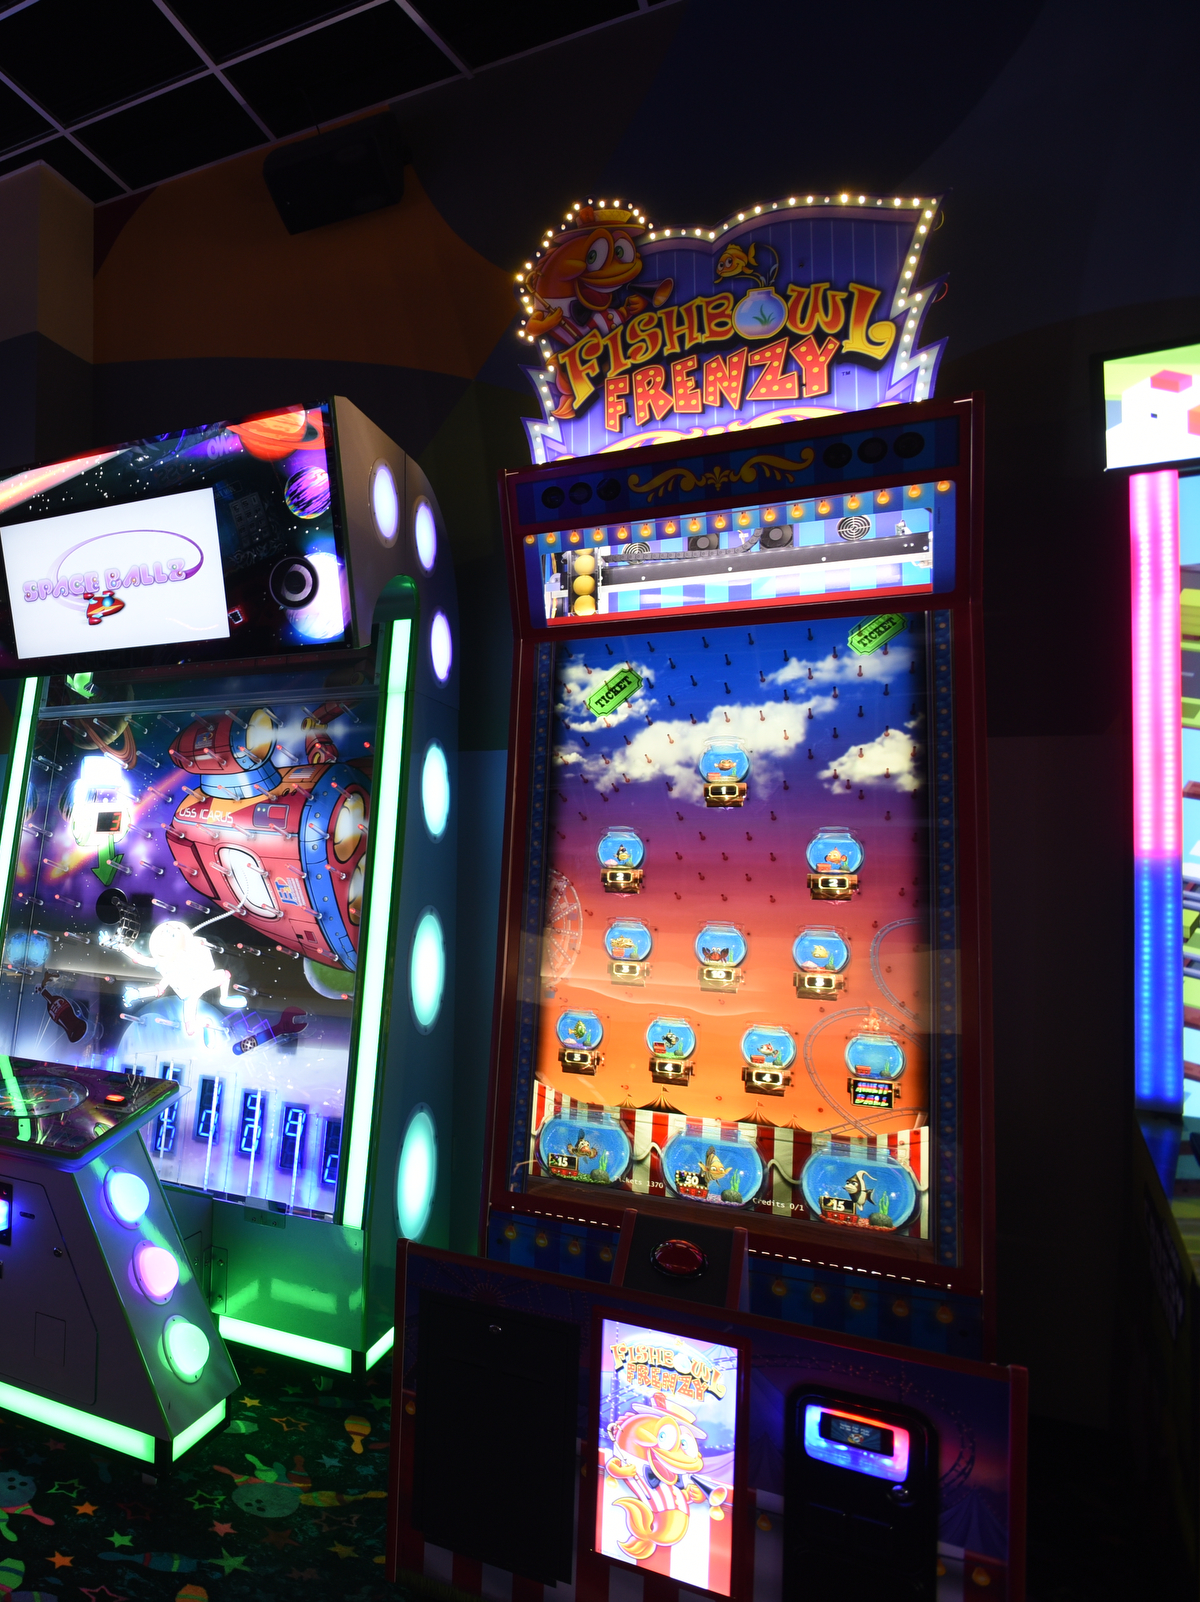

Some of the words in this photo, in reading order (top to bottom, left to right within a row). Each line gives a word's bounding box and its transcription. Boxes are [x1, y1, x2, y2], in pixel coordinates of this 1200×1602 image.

[604, 334, 841, 432] FRENZY
[22, 570, 100, 602] SPACE
[856, 616, 898, 648] TICKET
[594, 675, 633, 708] TICKET
[109, 812, 122, 831] 3
[178, 807, 198, 819] USS
[199, 810, 234, 824] ICARUS
[558, 1156, 569, 1168] 15
[646, 1180, 664, 1189] 1370
[685, 1174, 700, 1186] 50
[752, 1197, 786, 1209] Credits
[789, 1203, 805, 1212] 0/1
[833, 1200, 846, 1212] 15
[626, 1362, 710, 1402] FRENZY
